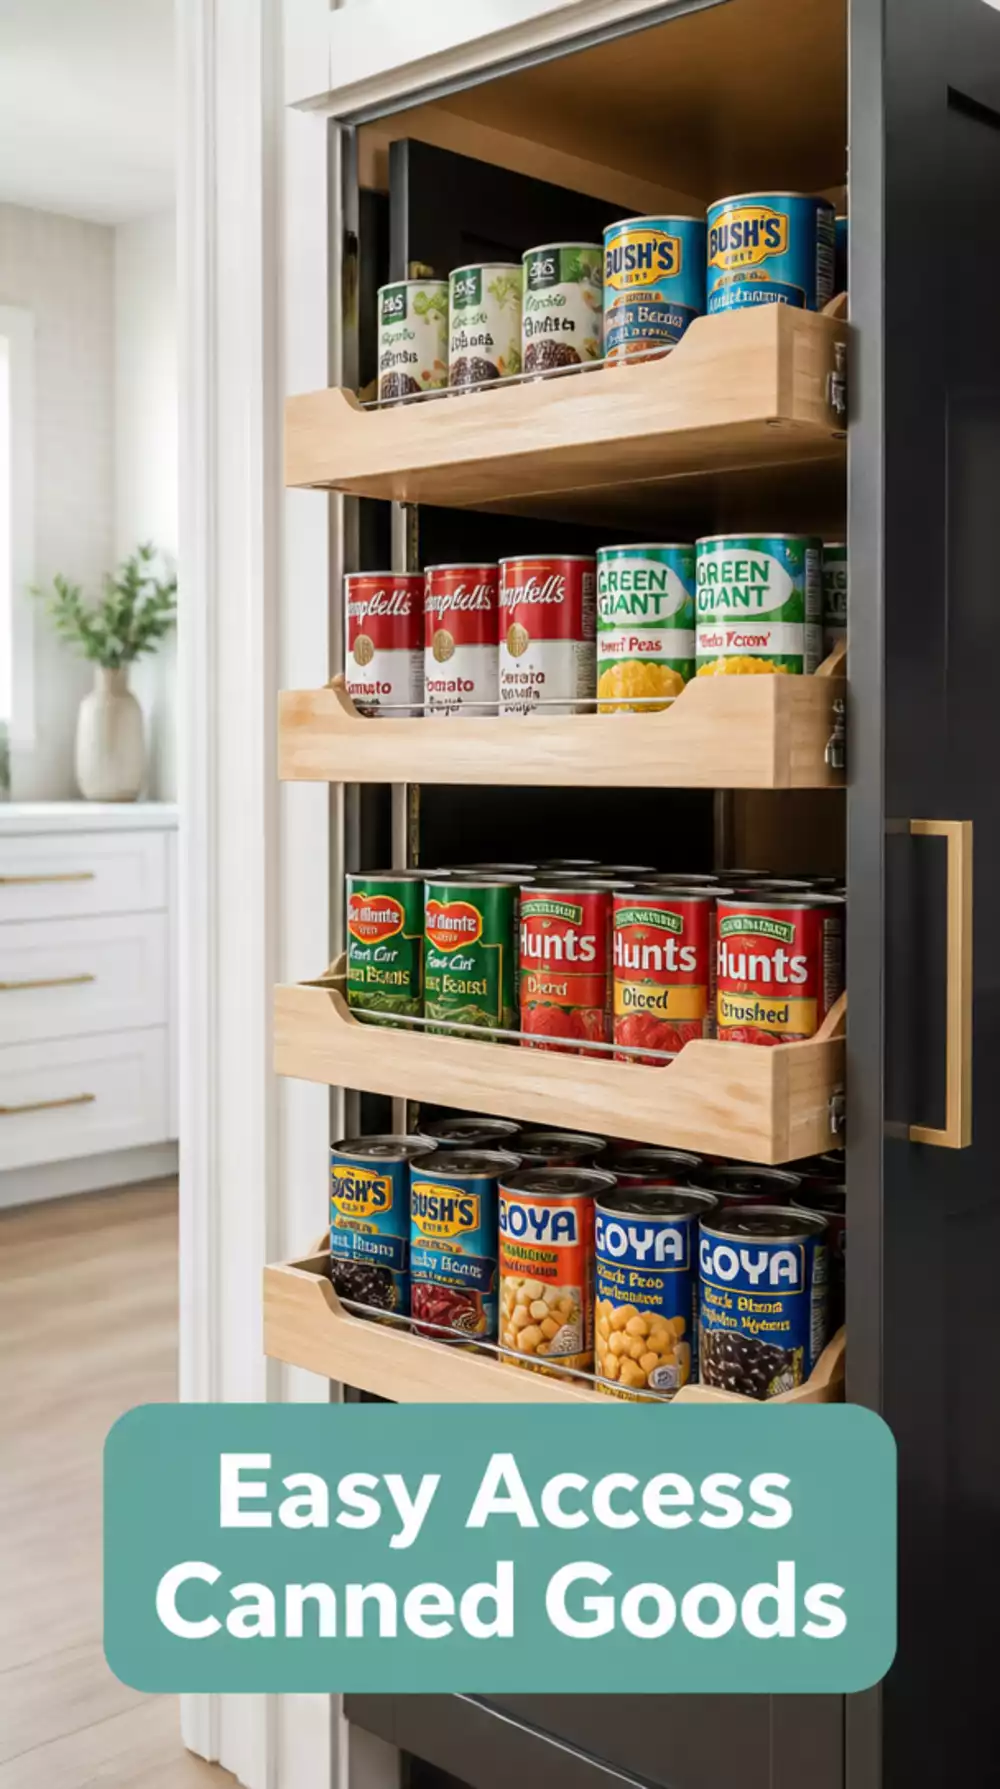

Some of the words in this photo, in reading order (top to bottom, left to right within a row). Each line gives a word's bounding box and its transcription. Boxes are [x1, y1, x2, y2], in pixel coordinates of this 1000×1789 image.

[709, 216, 781, 260] BUSH'S
[606, 239, 674, 278] BUSH'S
[599, 570, 668, 593] GREEN
[697, 560, 770, 586] GREEN
[499, 574, 566, 614] ampbell's
[599, 593, 669, 616] GIANT
[426, 676, 475, 692] omato
[613, 931, 697, 972] Hunts
[717, 941, 808, 984] Hunts
[622, 988, 669, 1010] Diced
[412, 1190, 474, 1227] BUSH'S
[595, 1217, 683, 1262] GOYA
[700, 1239, 798, 1285] GOYA
